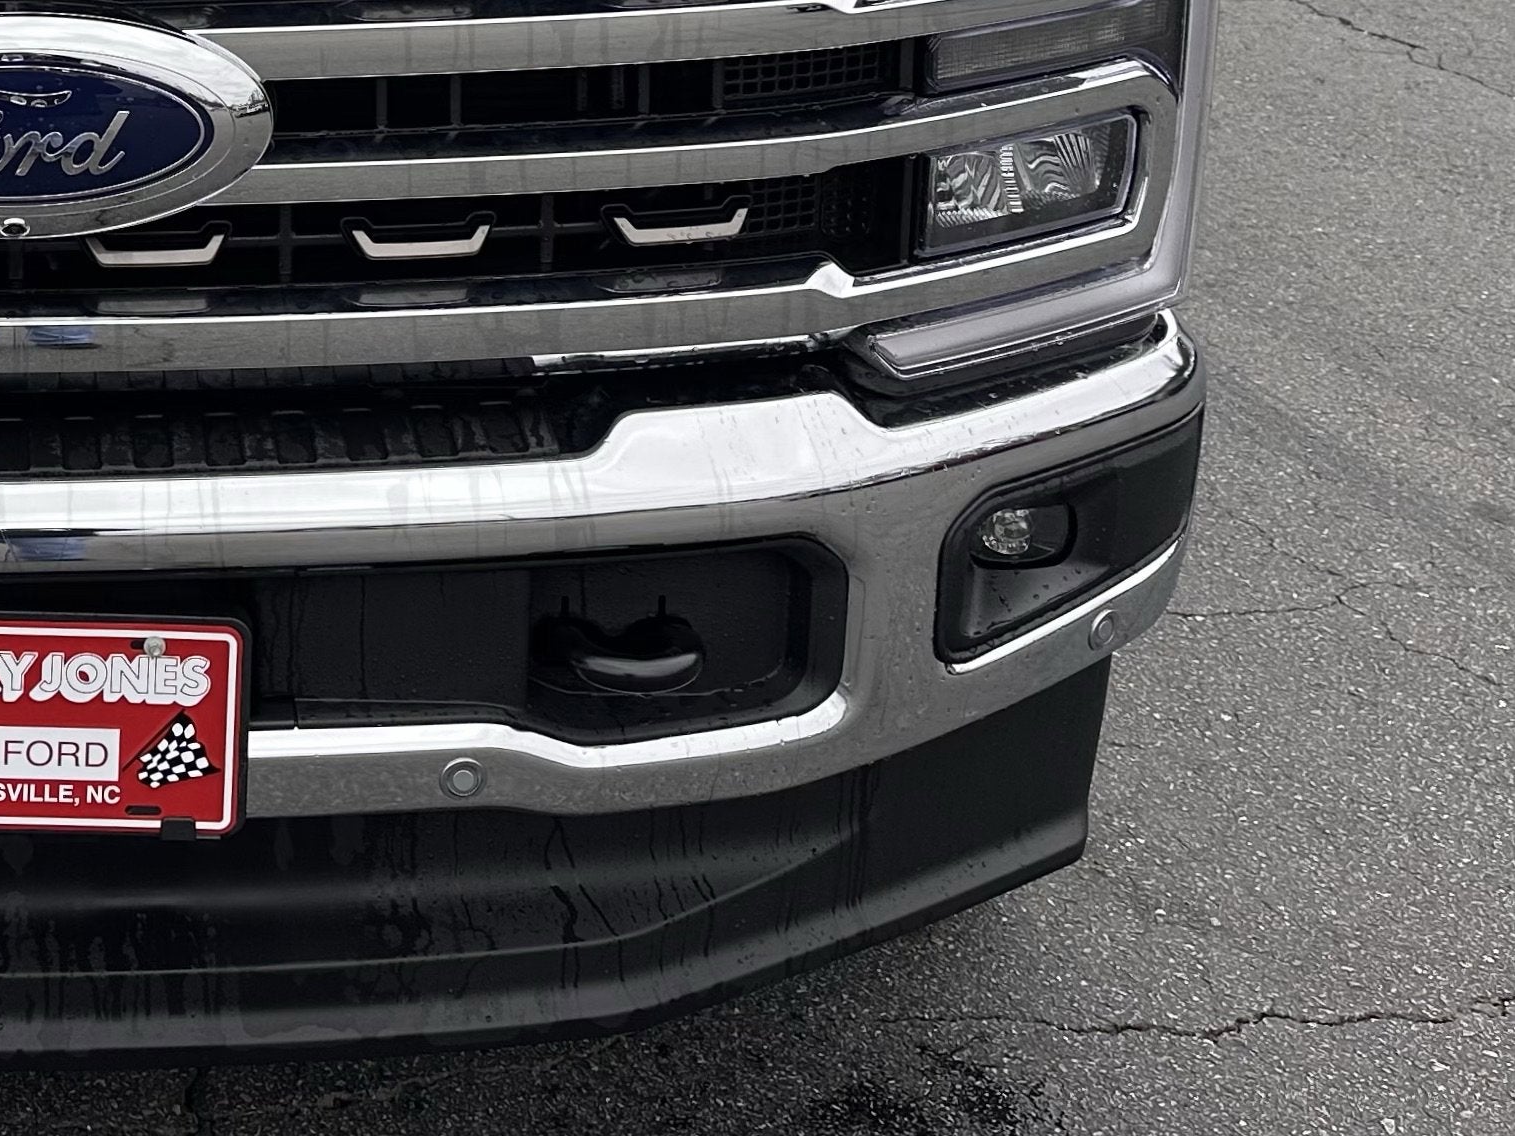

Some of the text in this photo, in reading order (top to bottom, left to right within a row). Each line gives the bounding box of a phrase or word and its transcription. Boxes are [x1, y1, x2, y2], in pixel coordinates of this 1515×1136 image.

[29, 651, 212, 707] JONES
[3, 739, 109, 768] FORD
[86, 784, 121, 805] NC
